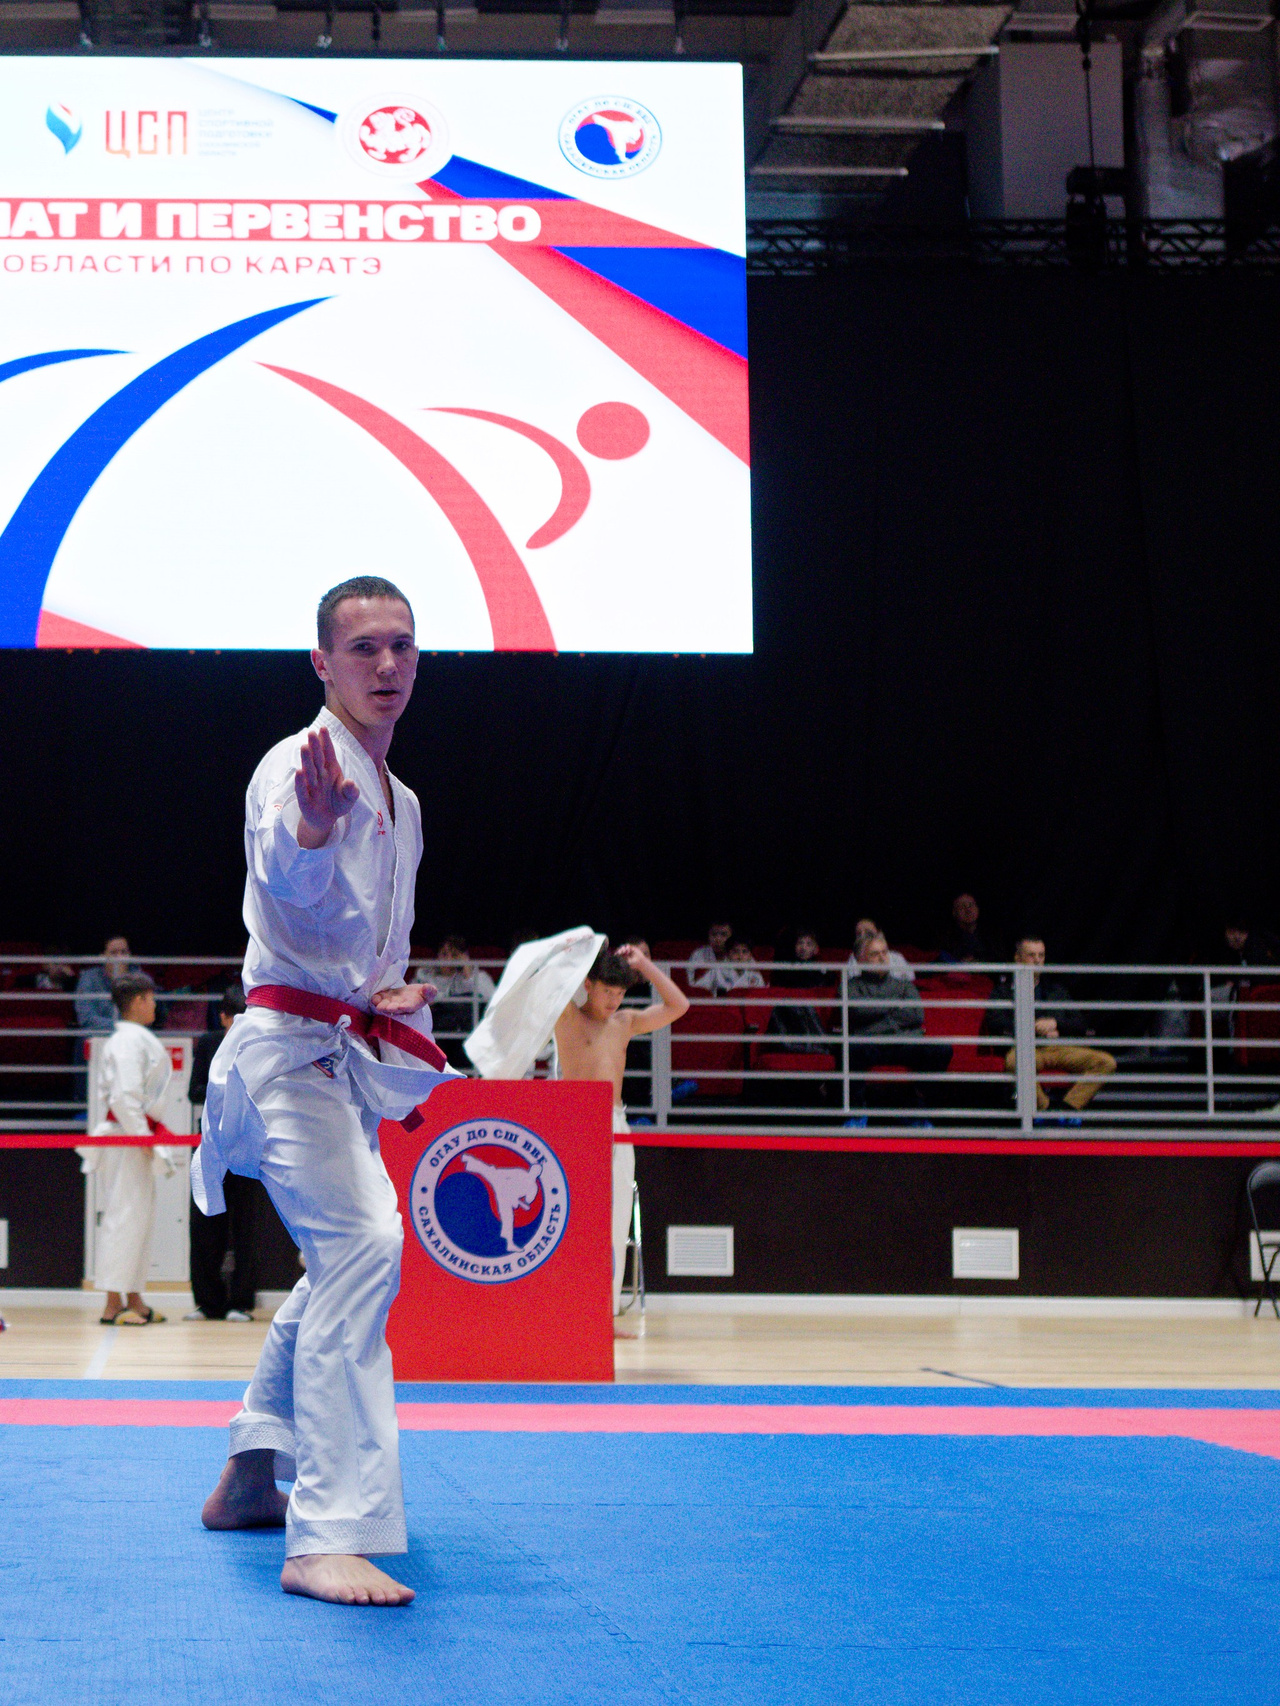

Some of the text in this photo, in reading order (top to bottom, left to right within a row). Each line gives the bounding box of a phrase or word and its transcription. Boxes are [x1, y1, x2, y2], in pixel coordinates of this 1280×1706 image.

[105, 110, 187, 159] ЦСП
[100, 202, 143, 238] И
[156, 203, 542, 242] ПЕРВЕНСТВО
[3, 255, 170, 272] ОБЛАСТИ
[185, 256, 231, 272] ПО
[247, 256, 381, 274] КАРАТЭ
[429, 1135, 461, 1168] ОГАУ
[467, 1128, 488, 1142] ДО
[493, 1128, 520, 1144] СШ
[418, 1203, 562, 1276] САХАЛИНСКАЯ ОБЛАСТЬ
